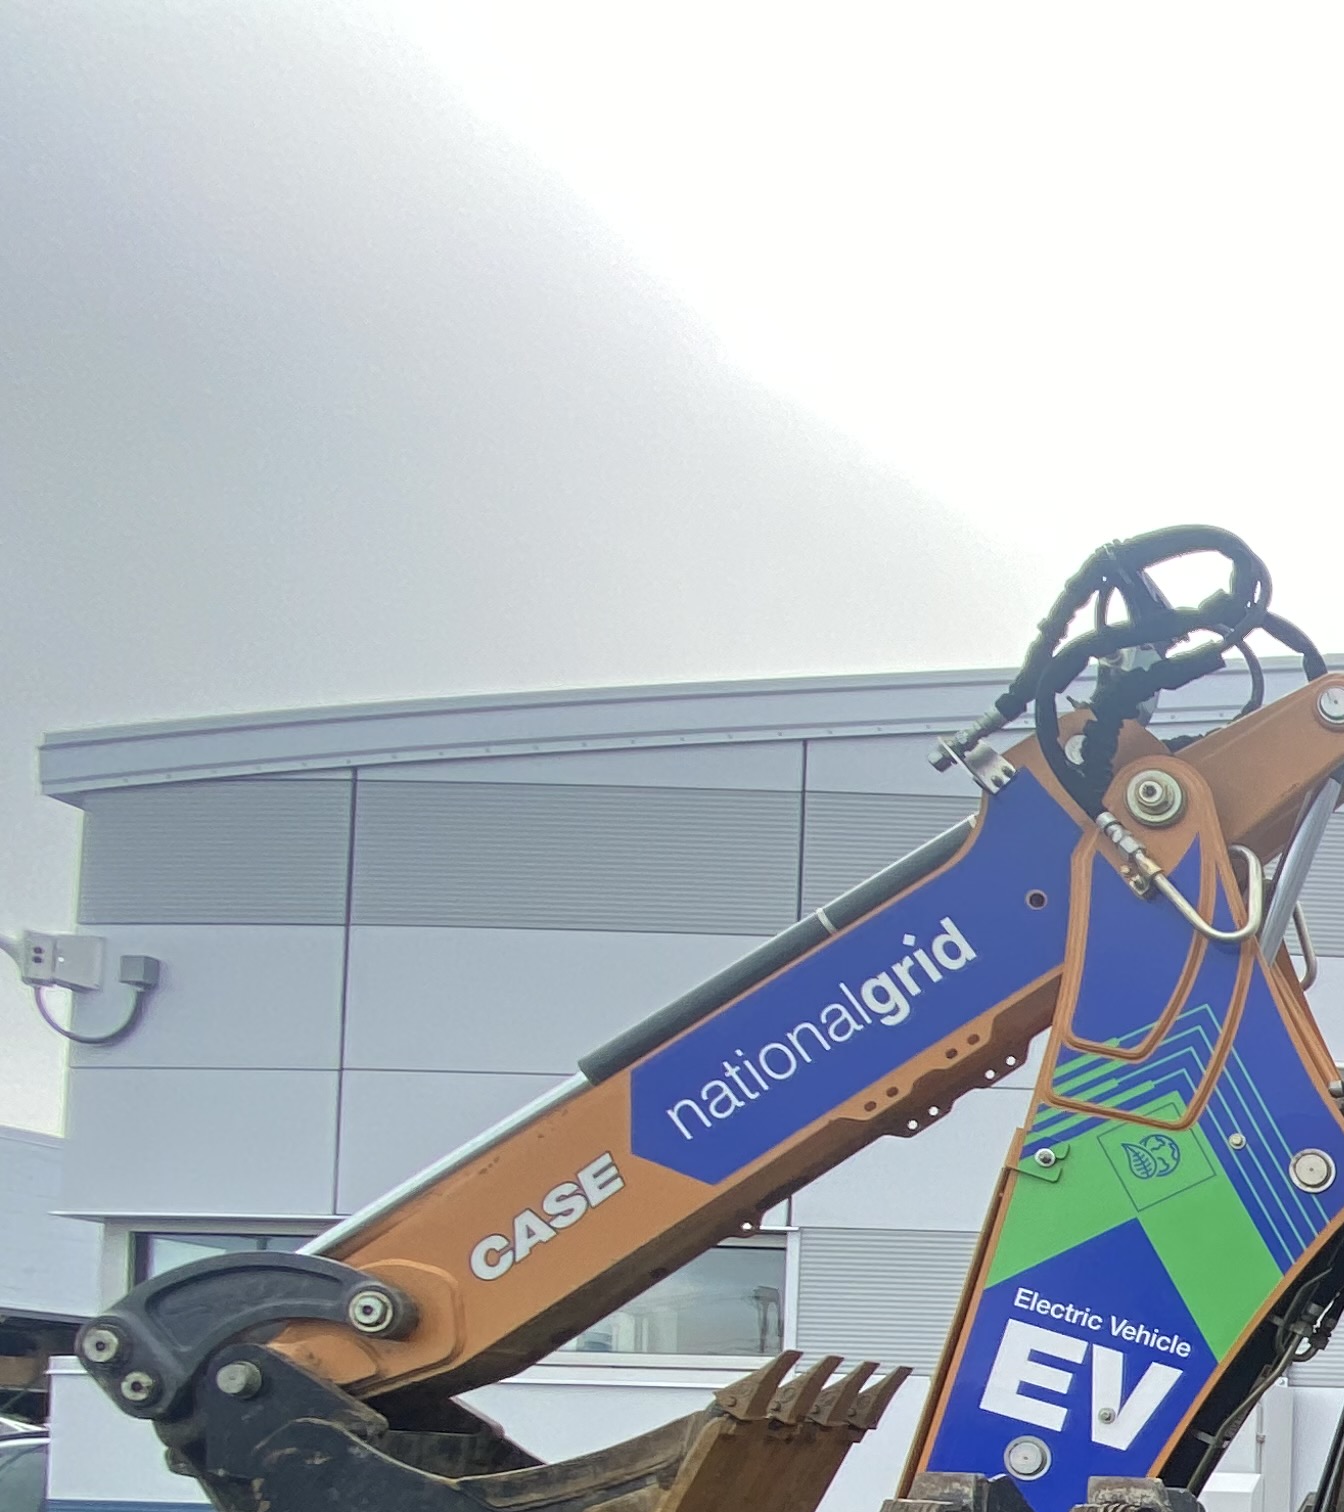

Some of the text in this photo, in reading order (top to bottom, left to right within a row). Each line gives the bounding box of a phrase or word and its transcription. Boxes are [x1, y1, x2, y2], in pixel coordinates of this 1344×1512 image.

[666, 917, 977, 1140] nationalgrid
[469, 1152, 625, 1281] CASE
[979, 1319, 1183, 1451] EV
[1013, 1287, 1191, 1357] Electric Vehicle
